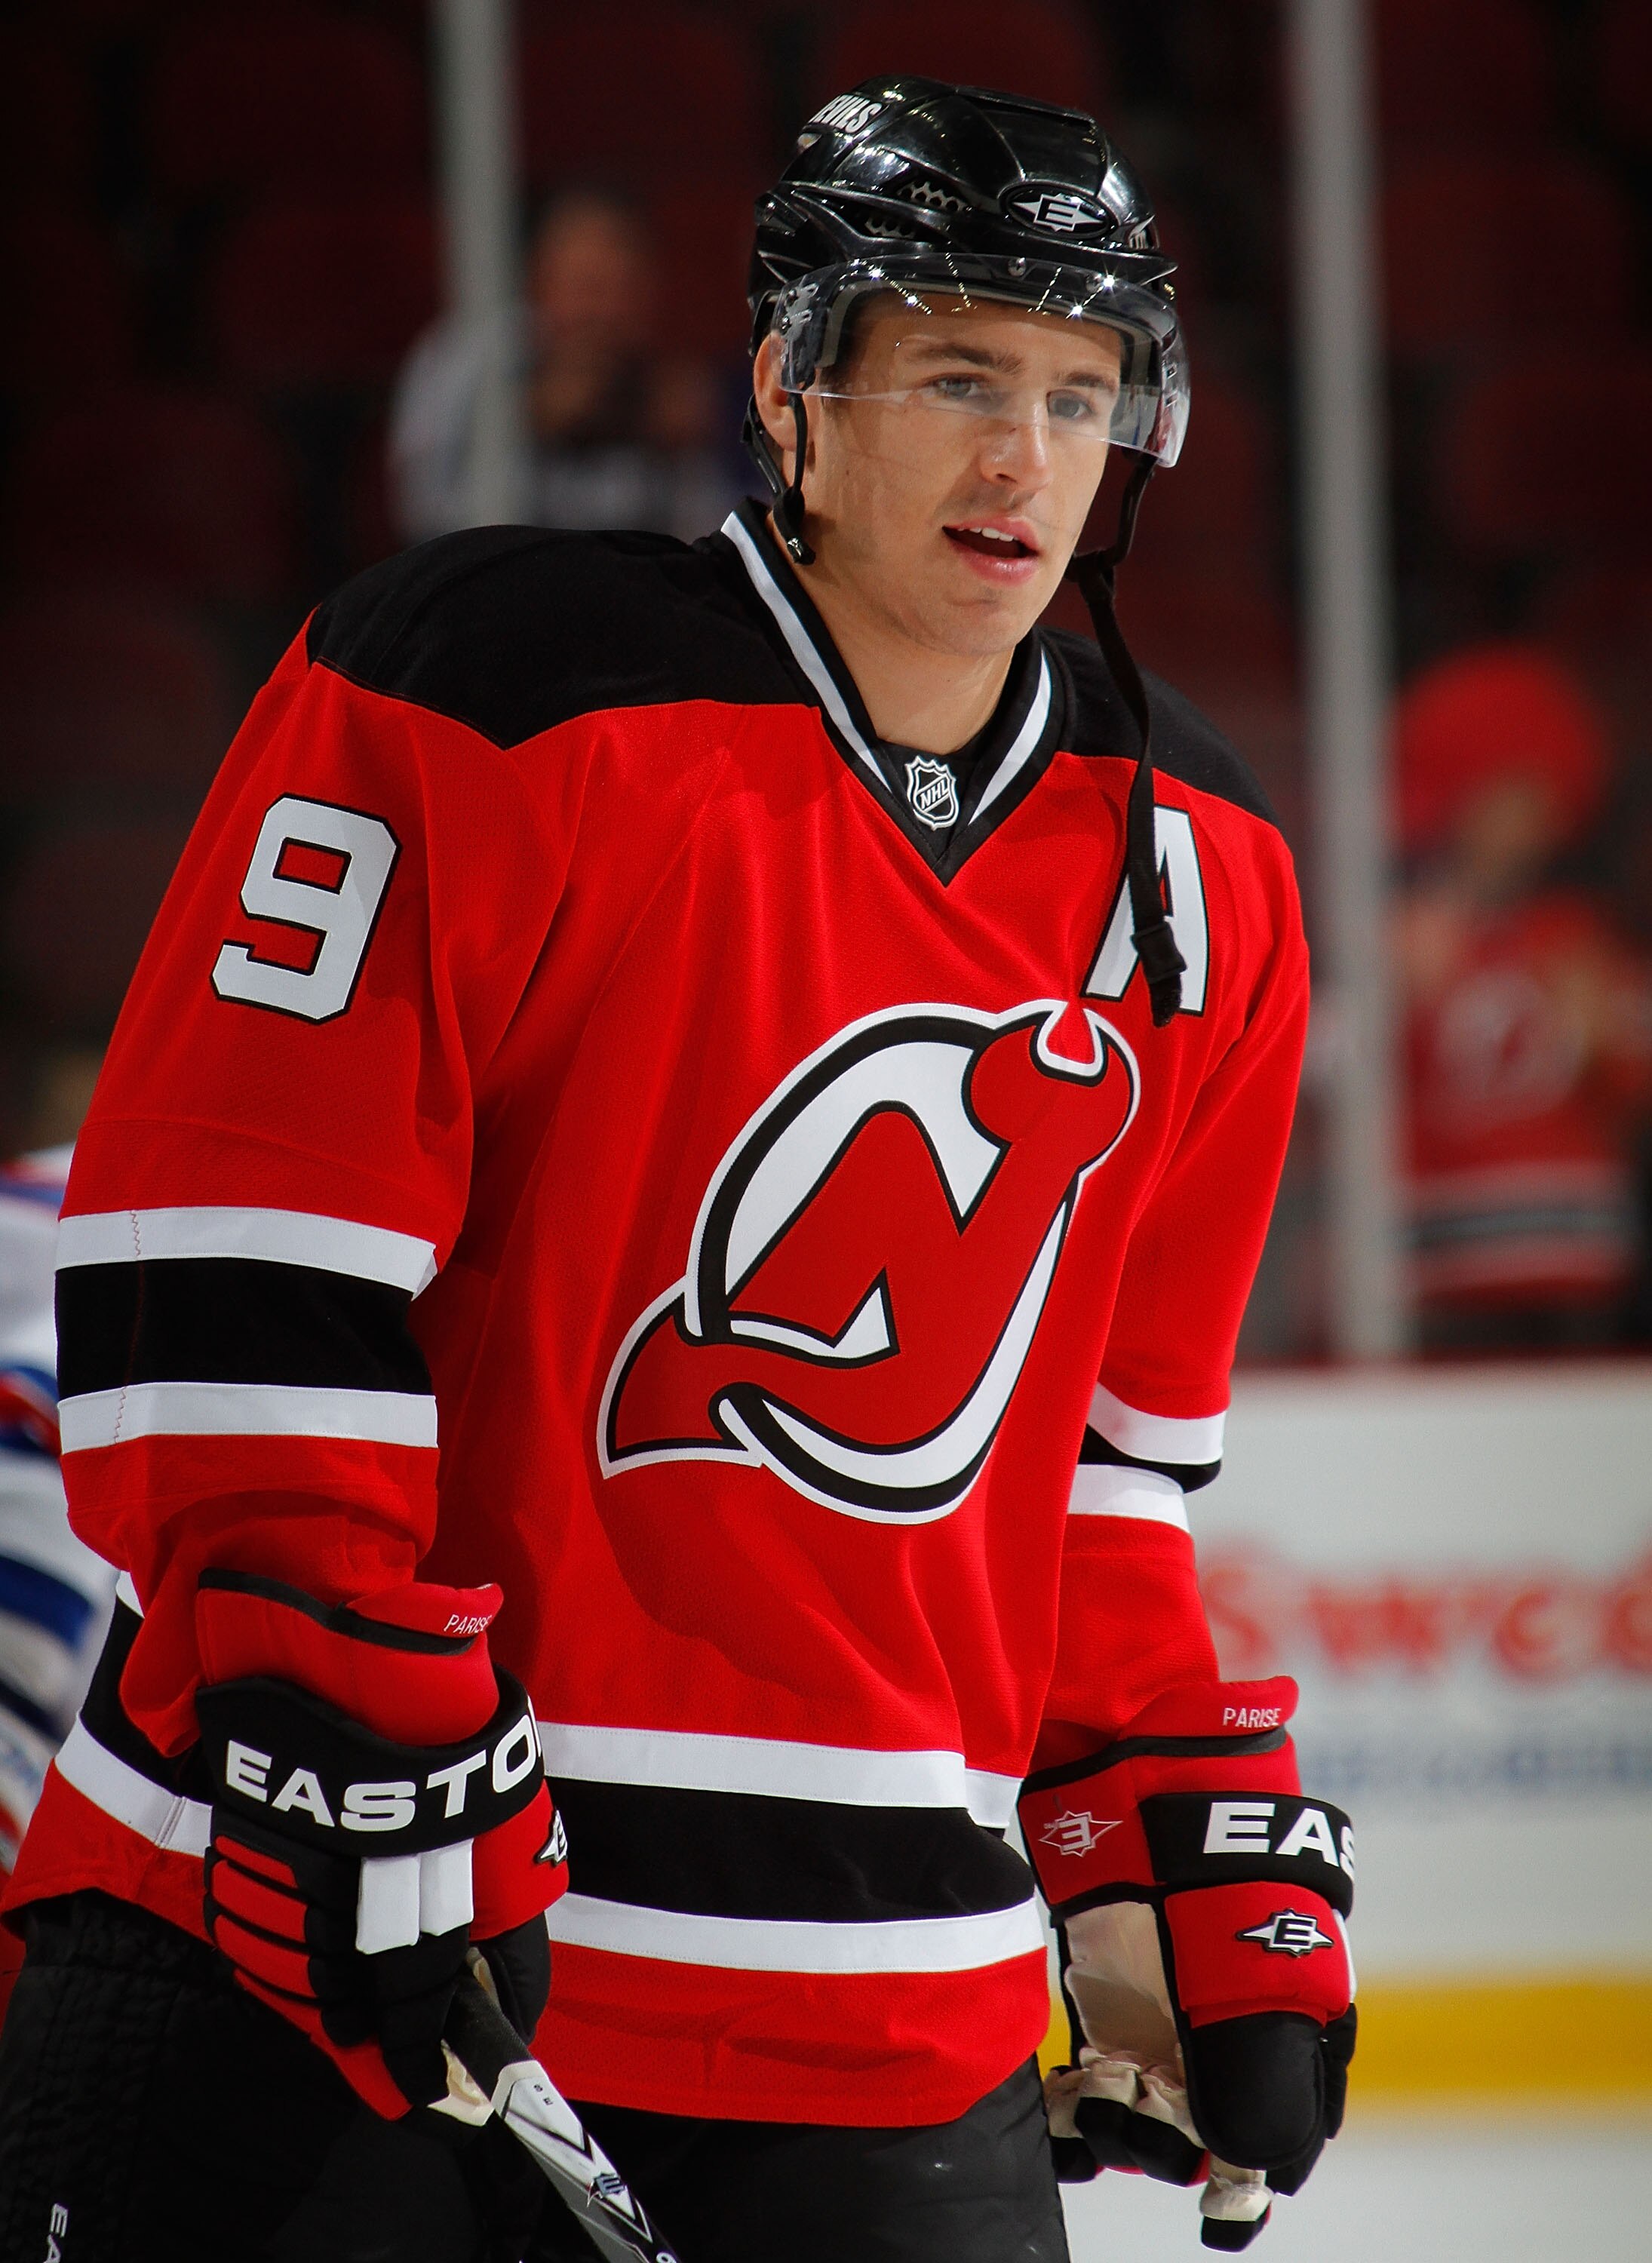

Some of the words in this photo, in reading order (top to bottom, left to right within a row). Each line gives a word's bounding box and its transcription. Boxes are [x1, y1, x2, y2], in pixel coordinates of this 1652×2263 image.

[807, 94, 883, 134] EVILS
[920, 779, 950, 810] NHL
[210, 792, 402, 1024] 9
[1222, 1707, 1282, 1728] PARISE
[226, 1694, 542, 1832] EASTO
